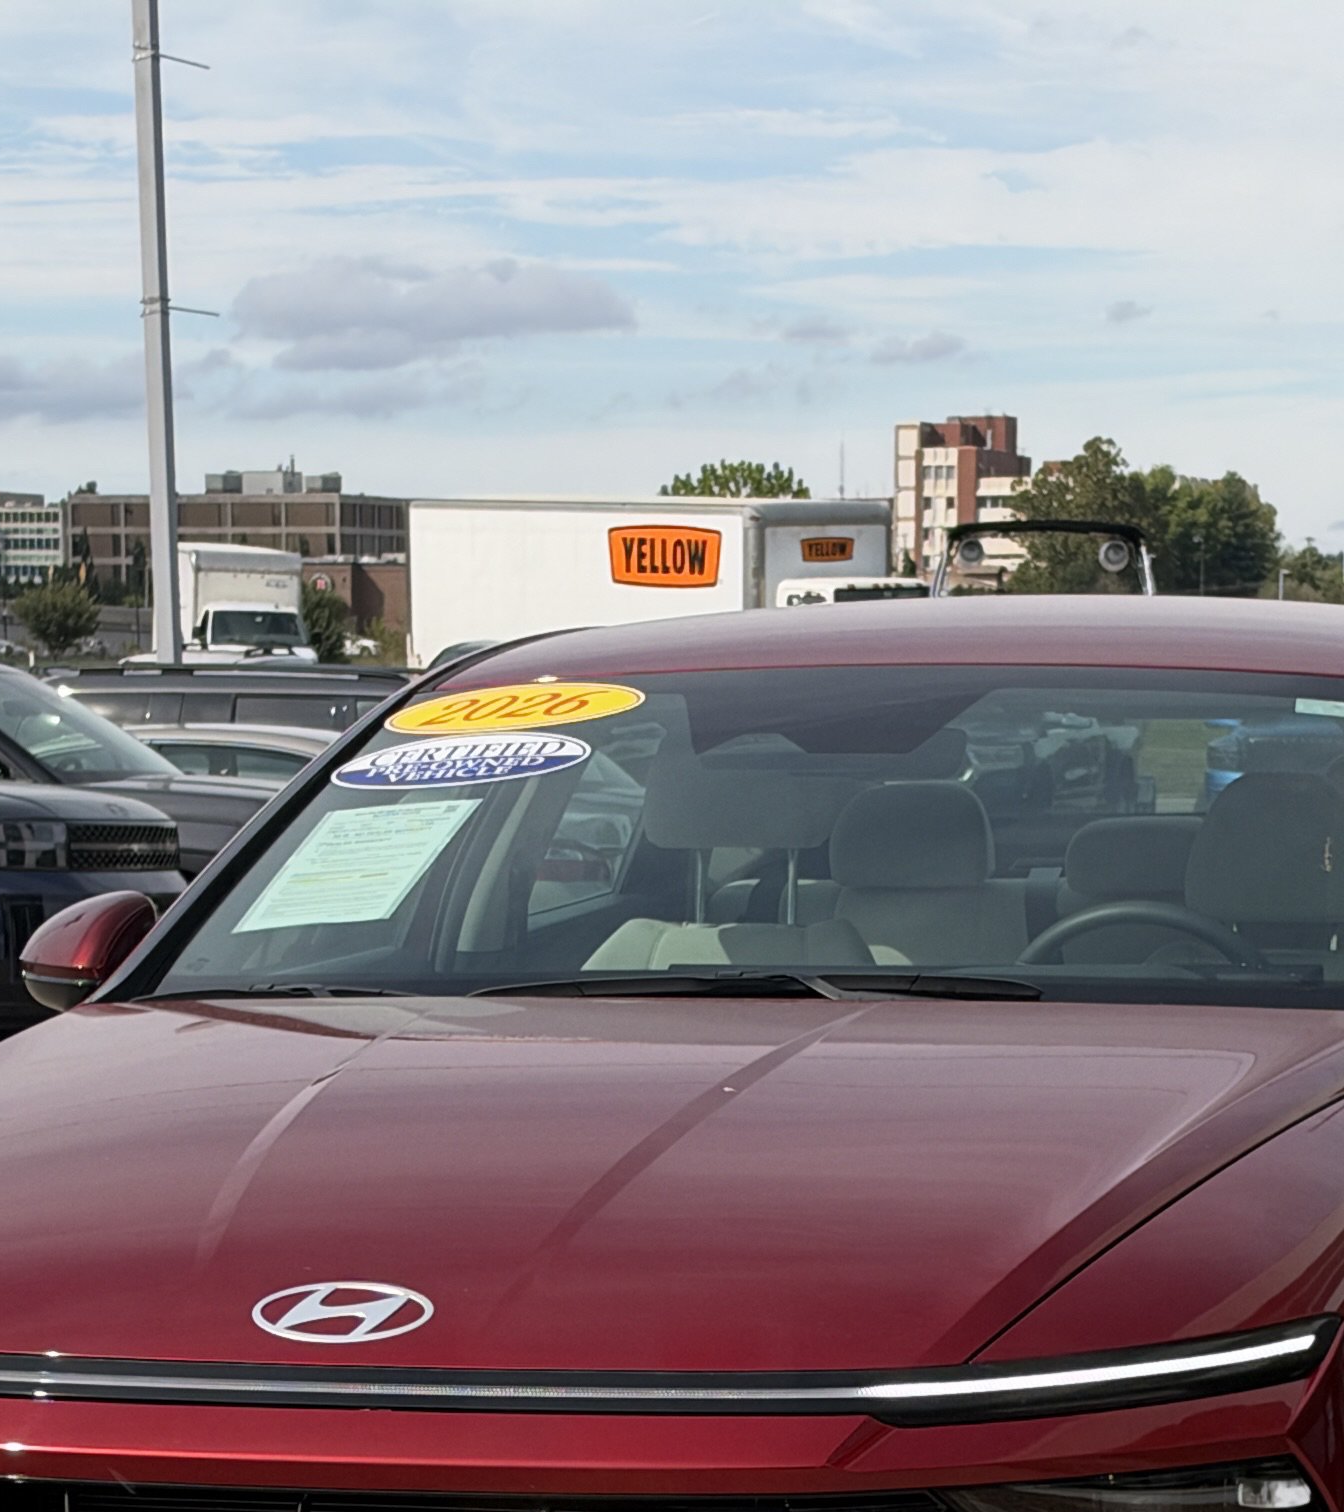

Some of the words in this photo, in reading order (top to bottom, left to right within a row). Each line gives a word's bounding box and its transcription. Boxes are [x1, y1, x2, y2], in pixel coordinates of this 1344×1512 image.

[622, 536, 707, 576] YELLOW
[807, 541, 847, 558] YELLOW
[417, 690, 610, 727] 2026
[366, 755, 546, 778] PRE-OWNED
[370, 740, 567, 768] CERTIFIED
[388, 766, 510, 783] VEHICLE
